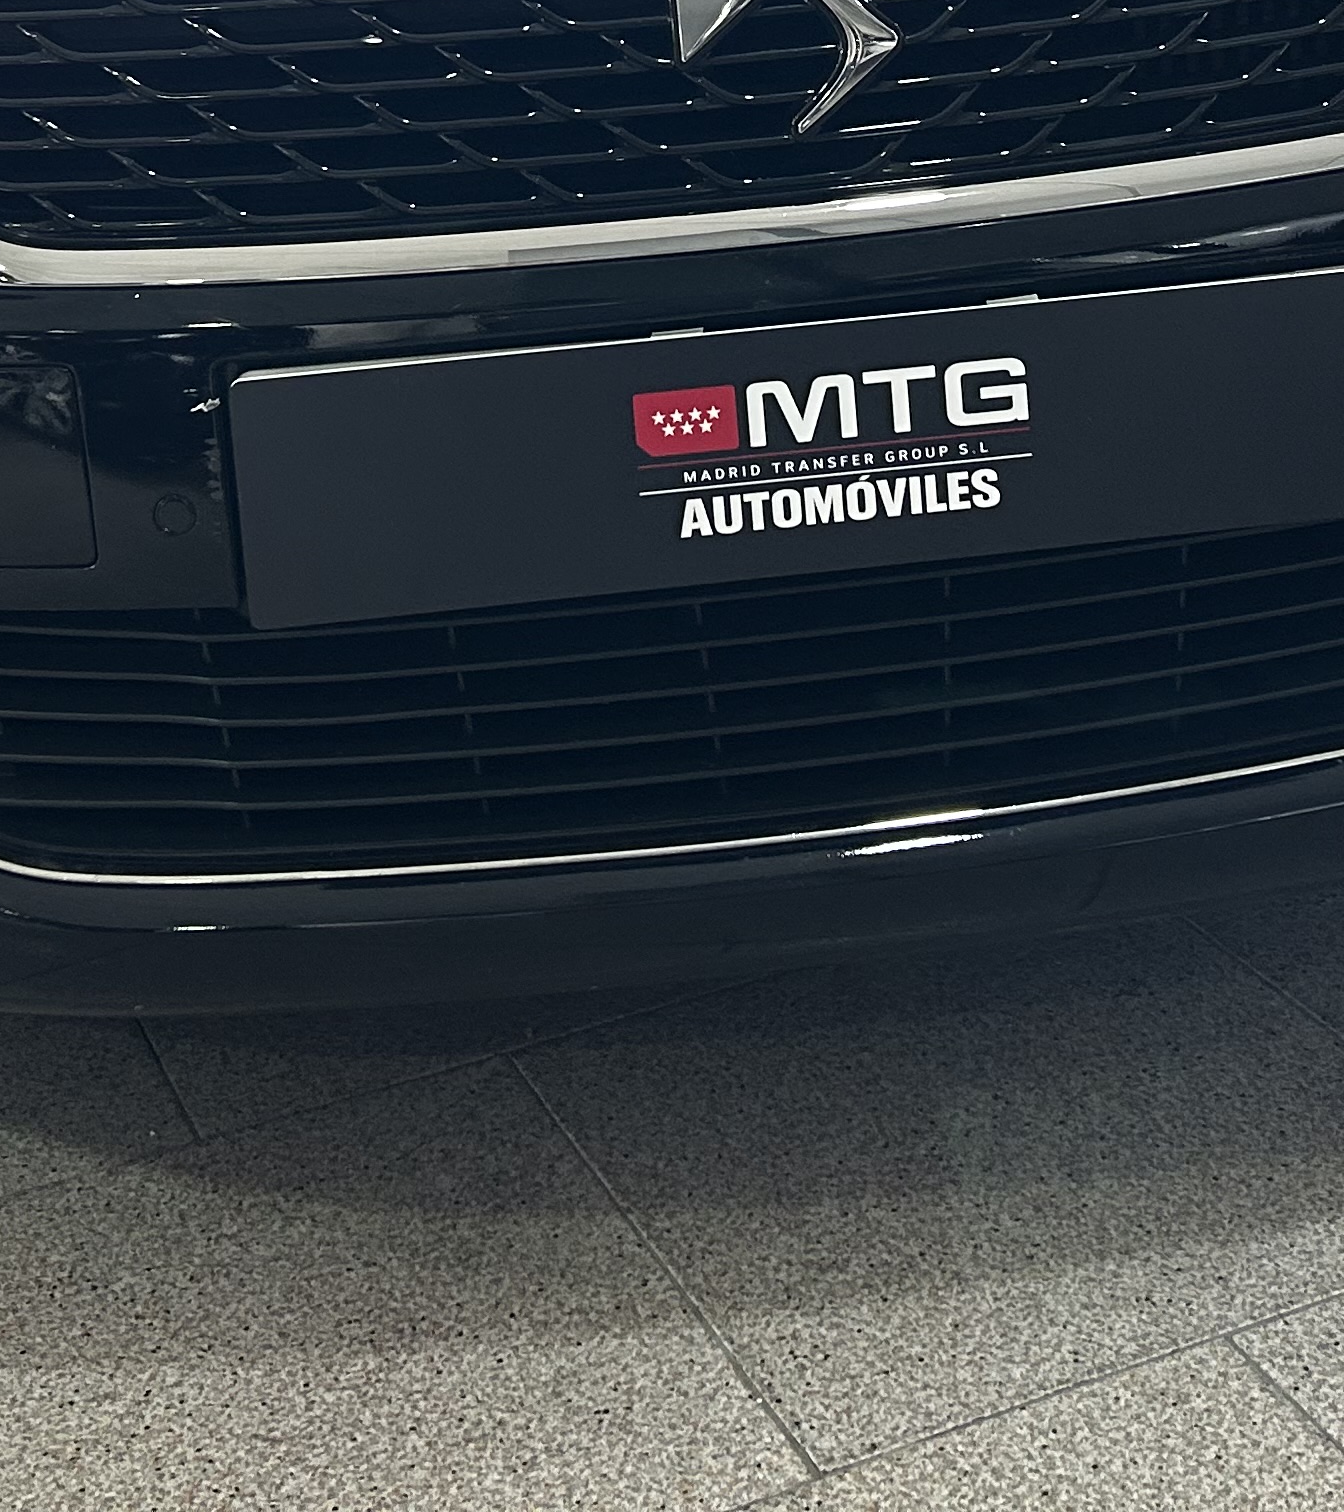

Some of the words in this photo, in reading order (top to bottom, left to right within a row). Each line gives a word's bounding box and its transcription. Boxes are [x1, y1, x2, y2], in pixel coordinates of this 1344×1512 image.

[745, 357, 1030, 448] MTG
[683, 464, 761, 484] MADRID
[771, 452, 874, 475] TRANSFER
[884, 444, 949, 464] GROUP
[680, 468, 1001, 539] AUTOMÓVILES
